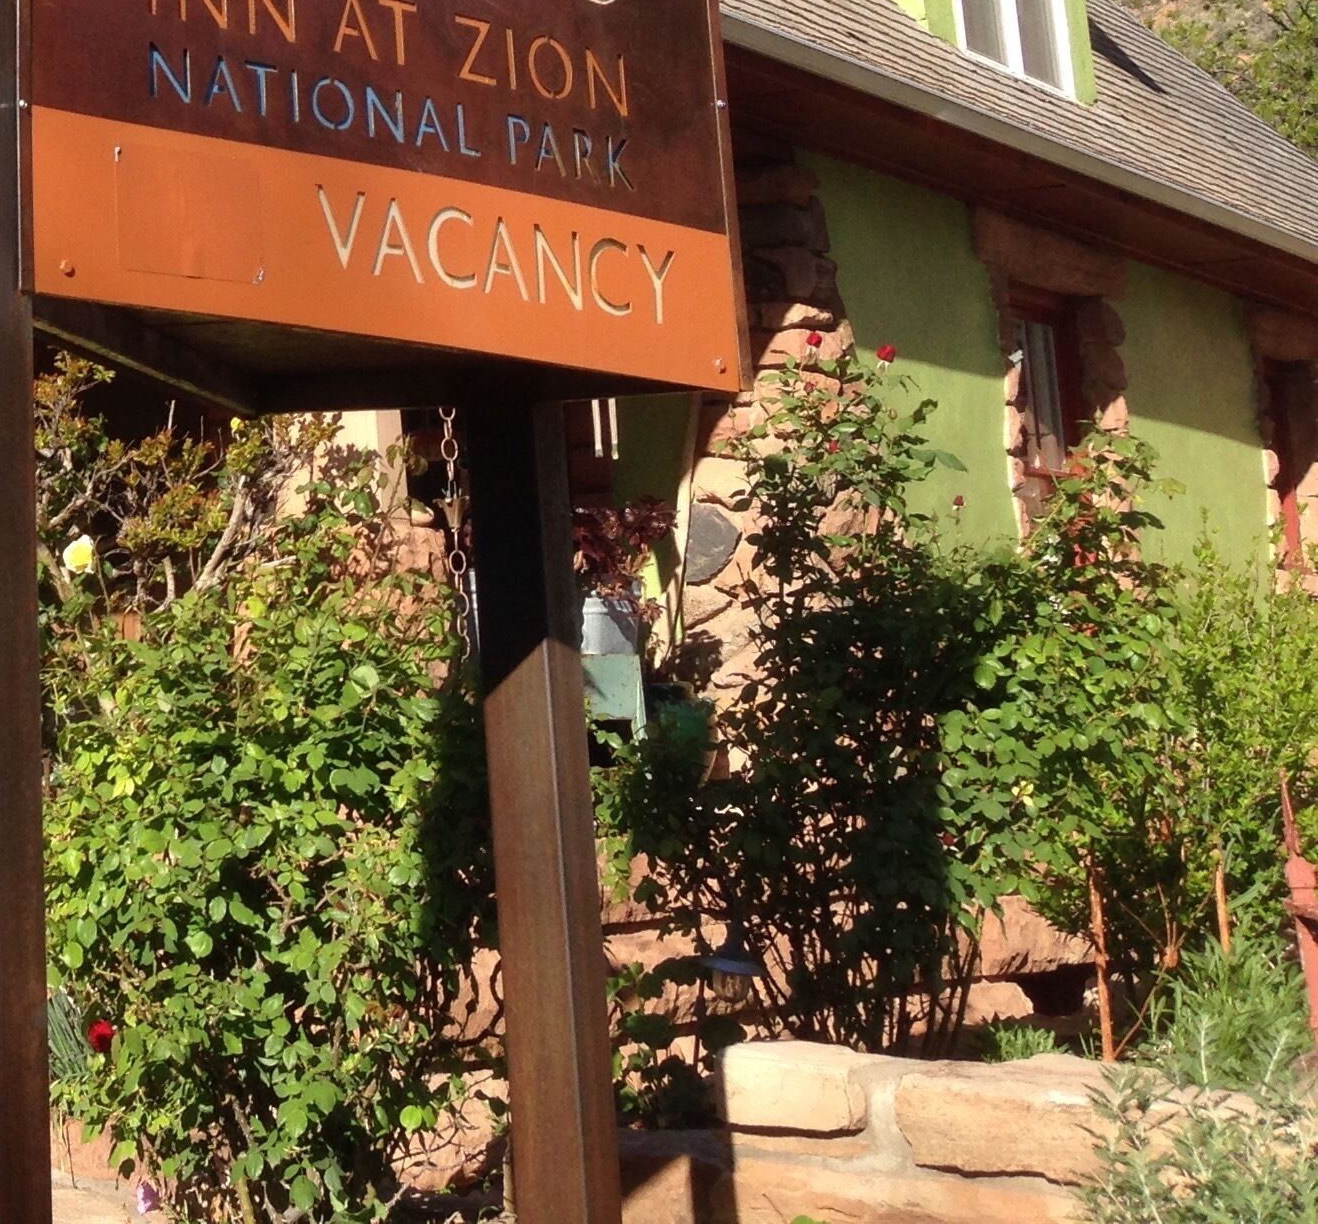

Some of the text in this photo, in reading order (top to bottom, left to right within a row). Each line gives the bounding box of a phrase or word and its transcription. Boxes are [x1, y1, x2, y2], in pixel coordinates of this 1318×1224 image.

[149, 41, 635, 191] NATIONAL PARK
[454, 14, 629, 117] ZION
[315, 184, 676, 325] VACANCY
